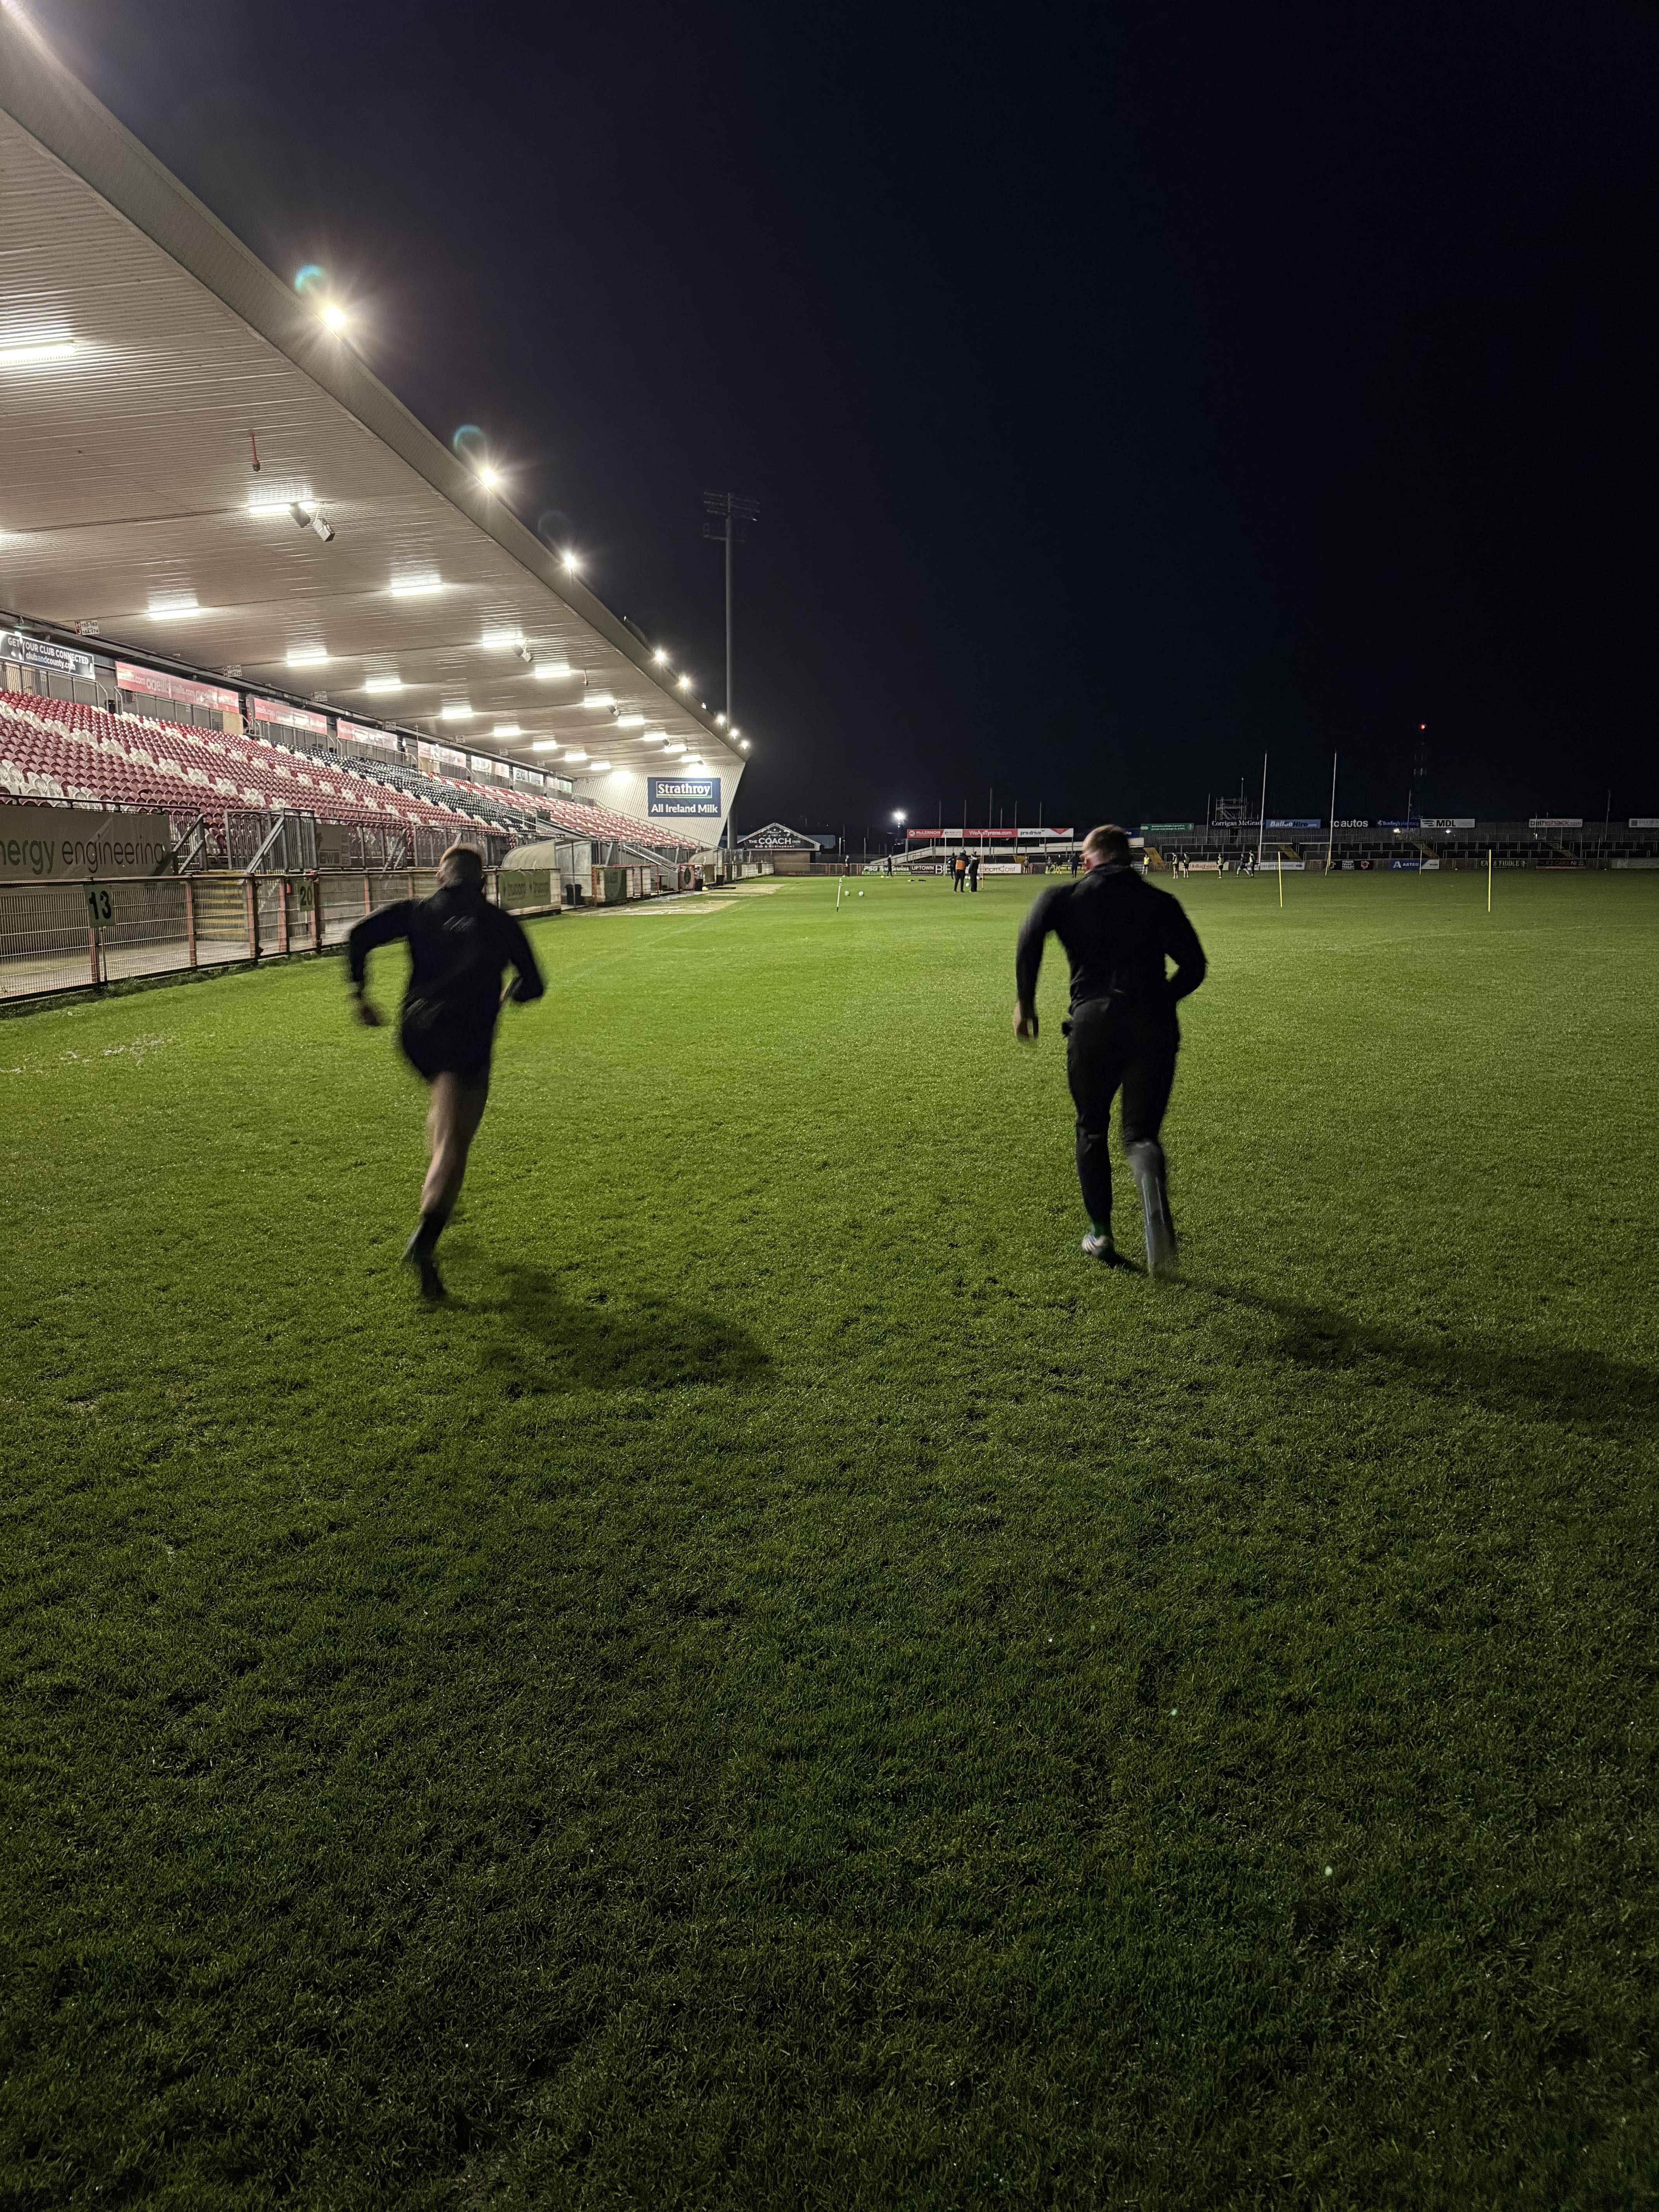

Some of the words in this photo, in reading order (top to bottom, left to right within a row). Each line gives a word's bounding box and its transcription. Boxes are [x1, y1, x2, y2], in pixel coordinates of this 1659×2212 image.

[8, 637, 20, 647] GET
[21, 641, 38, 652] YOUR
[40, 645, 55, 656] CLUB
[55, 649, 89, 665] CONNECTED
[26, 652, 76, 670] clubandcounty.com
[658, 783, 711, 795] Strathroy
[651, 804, 663, 813] All
[665, 804, 696, 813] Ireland
[698, 804, 718, 813] Milk
[89, 890, 112, 920] 13
[300, 886, 313, 906] 20
